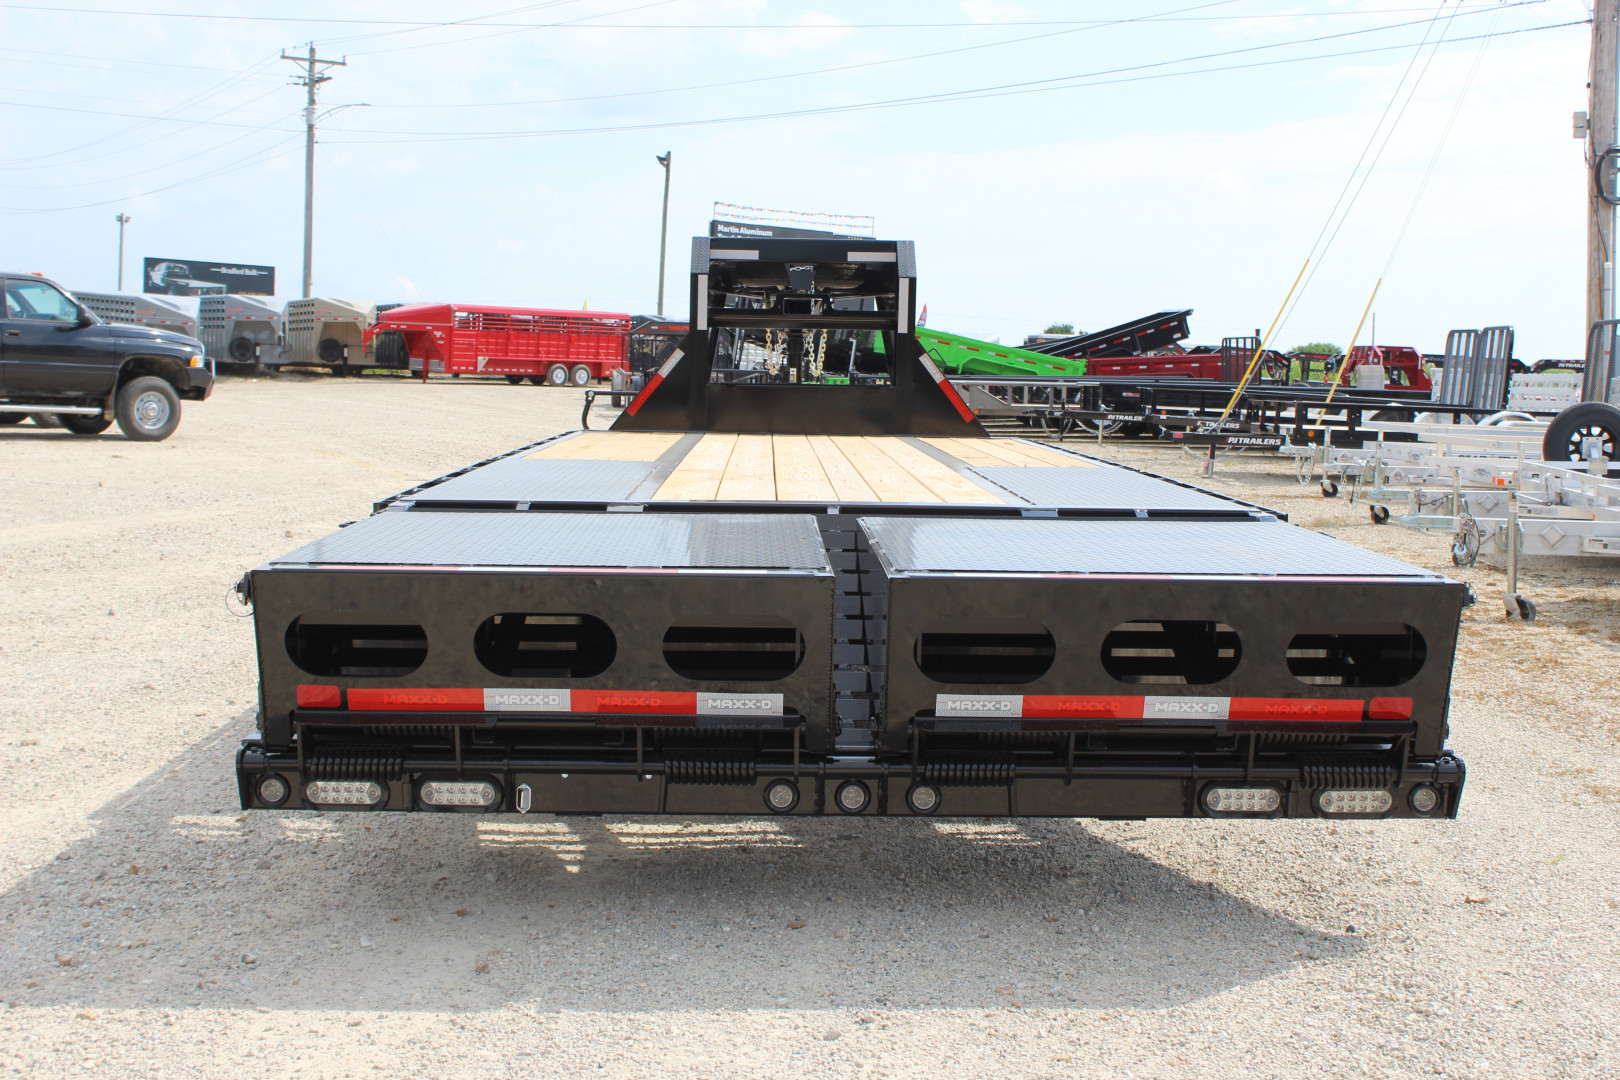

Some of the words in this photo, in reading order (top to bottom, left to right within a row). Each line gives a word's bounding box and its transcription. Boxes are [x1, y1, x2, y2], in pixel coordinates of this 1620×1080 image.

[717, 224, 739, 233] Martin
[740, 226, 773, 237] Aluminum
[1228, 436, 1238, 444] PJ
[1238, 437, 1282, 446] TRAILERS
[383, 694, 448, 705] MAXX-D
[495, 694, 560, 705] MAXX-D
[596, 696, 661, 707] MAXX-D
[707, 698, 772, 710] MAXX-D
[947, 700, 1012, 711] MAXX-D
[1057, 701, 1122, 712] MAXX-D
[1154, 702, 1219, 713] MAXX-D
